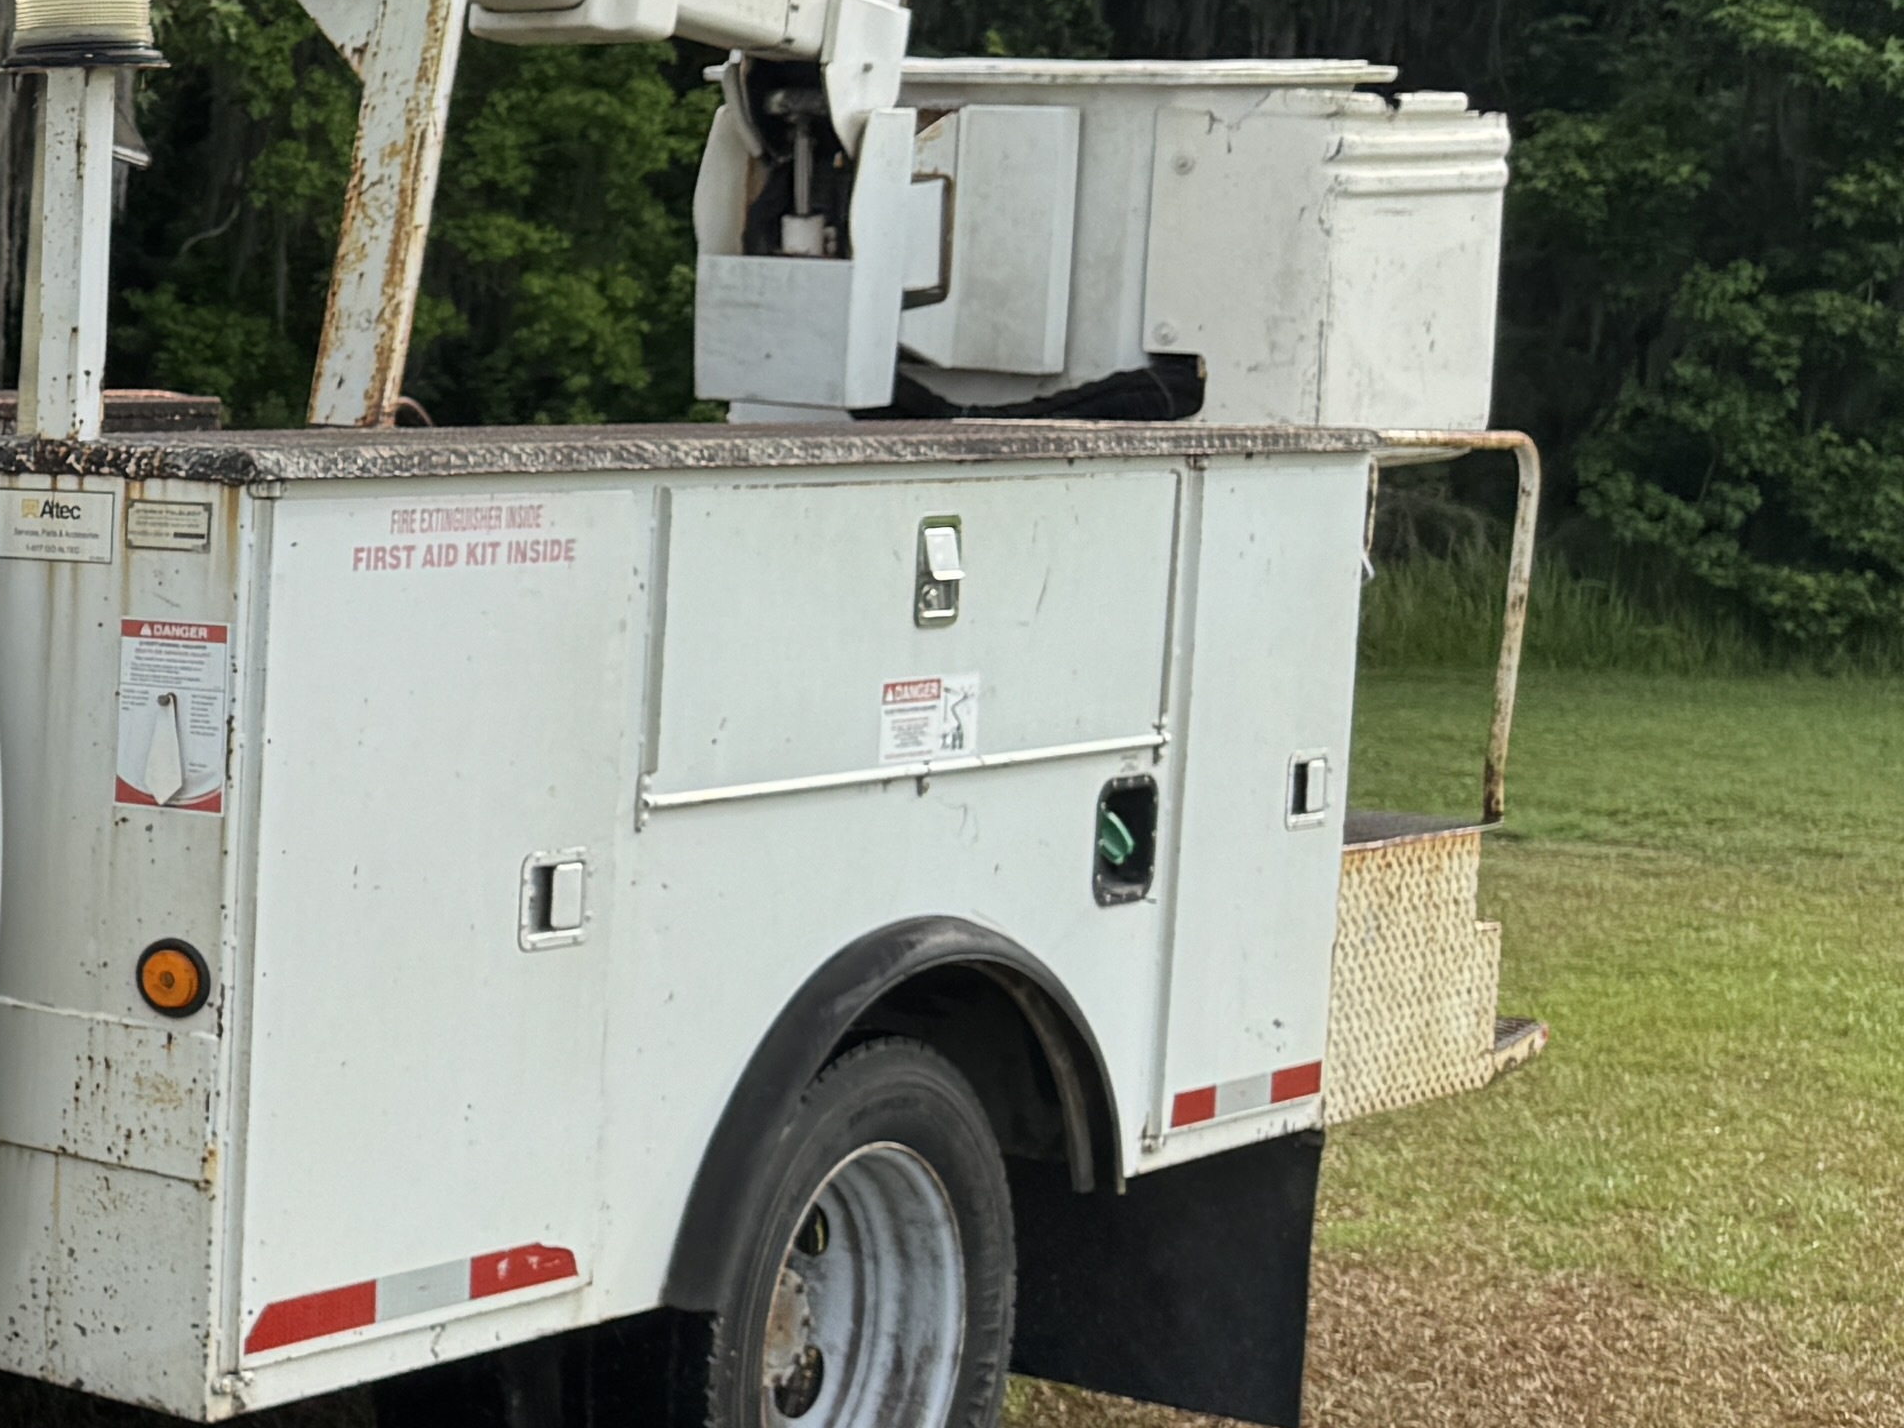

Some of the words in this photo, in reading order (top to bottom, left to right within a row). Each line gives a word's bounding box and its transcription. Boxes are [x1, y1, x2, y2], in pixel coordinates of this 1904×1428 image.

[39, 499, 81, 521] Altec
[390, 509, 417, 535] FIRE
[419, 506, 503, 534] EXTINGUISHER
[505, 503, 544, 529] INSIDE
[352, 544, 416, 571] FIRST
[421, 543, 459, 569] AID
[465, 541, 502, 567] KIT
[506, 538, 577, 565] INSIDE
[153, 623, 208, 639] DANGER
